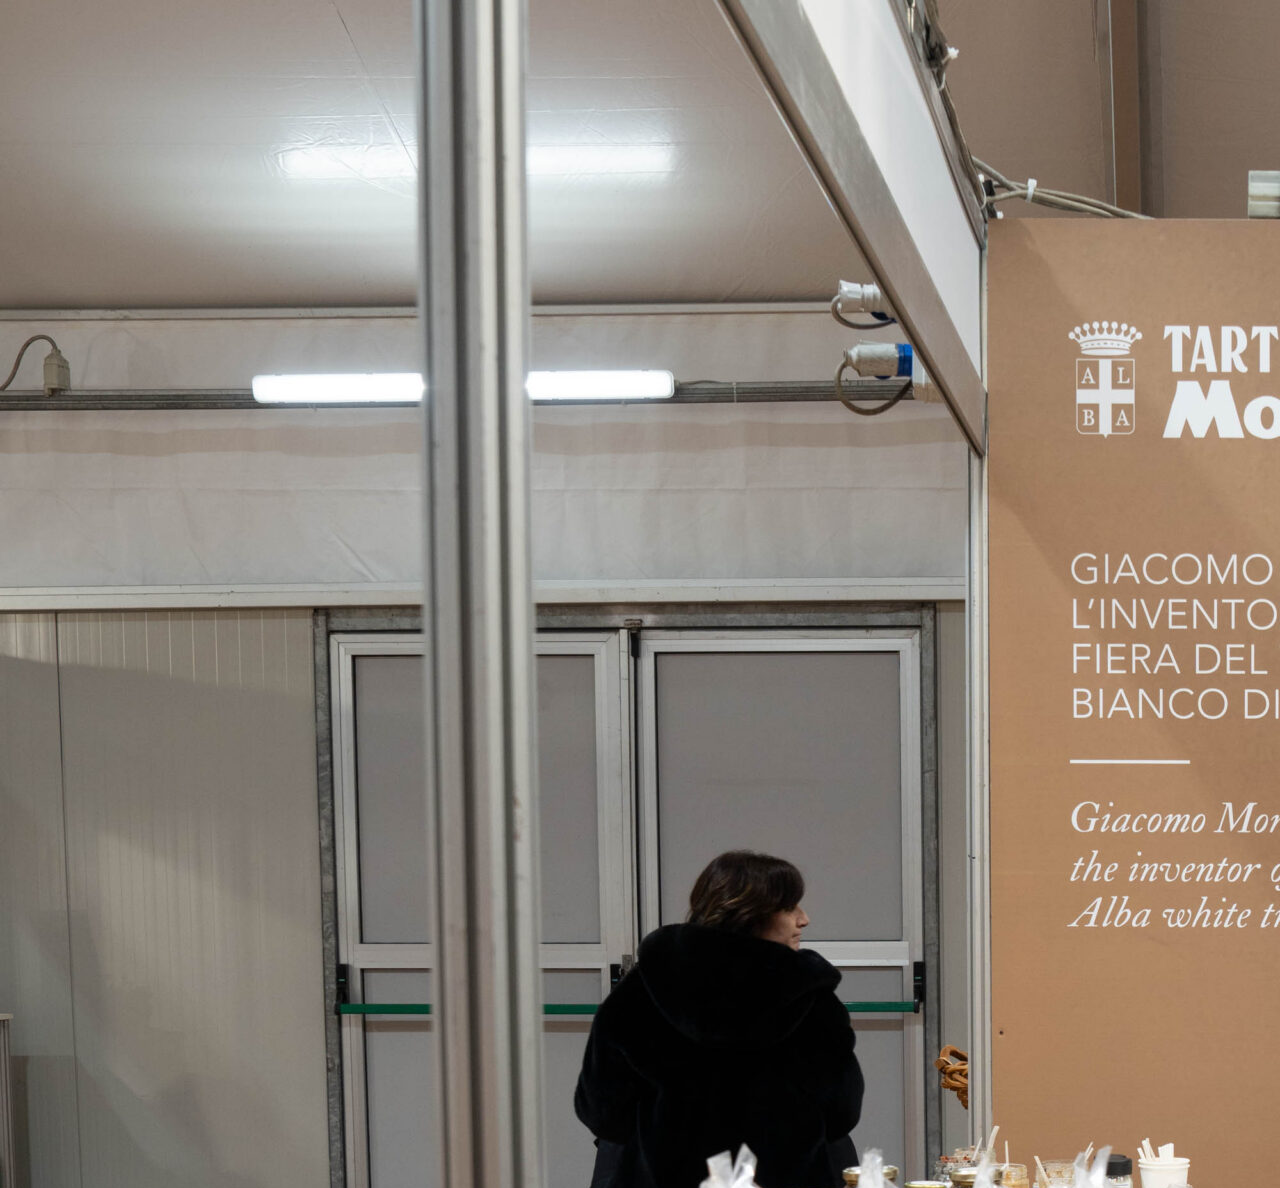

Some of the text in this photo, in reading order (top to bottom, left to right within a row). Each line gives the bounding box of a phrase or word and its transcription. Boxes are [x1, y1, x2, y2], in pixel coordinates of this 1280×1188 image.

[1080, 366, 1131, 384] A L
[1082, 408, 1131, 426] B A
[1071, 553, 1274, 586] GIACOMO
[1072, 643, 1181, 674] FIERA
[1195, 644, 1268, 675] DEL
[1072, 687, 1229, 720] BIANCO
[1243, 688, 1280, 720] DI
[1070, 801, 1206, 833] Giacomo
[1069, 849, 1119, 882] the
[1128, 850, 1261, 883] inventor
[1067, 895, 1152, 928] Alba
[1161, 895, 1252, 929] white
